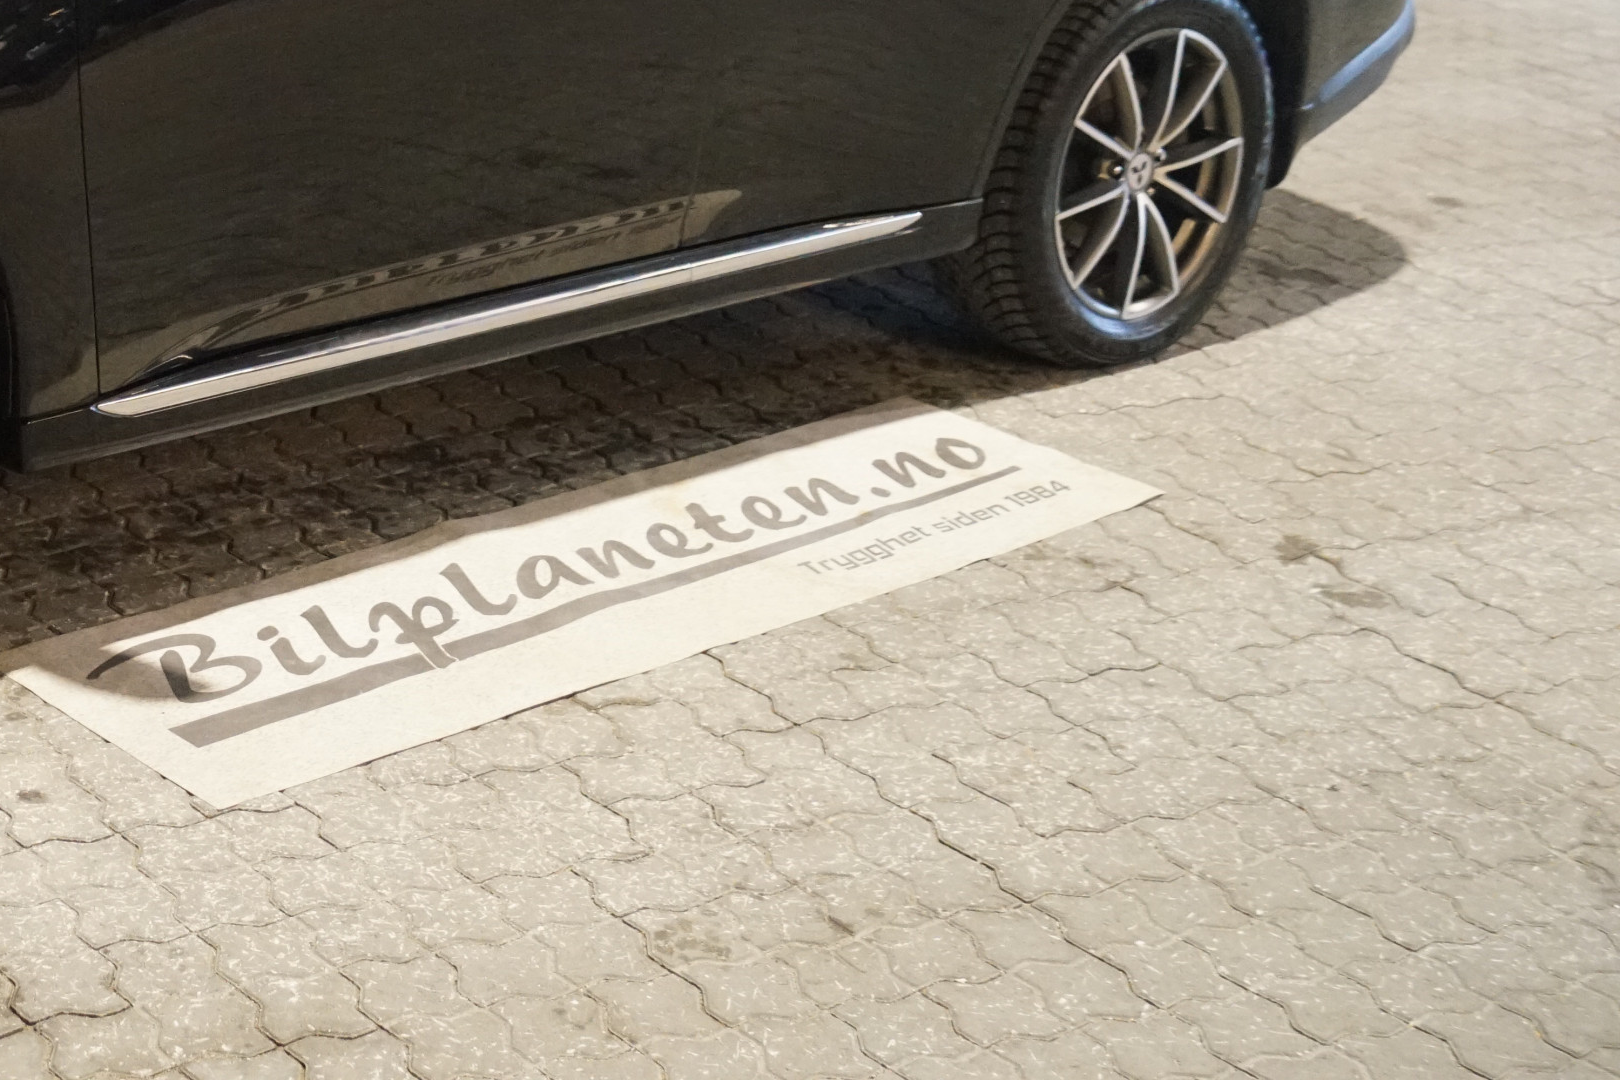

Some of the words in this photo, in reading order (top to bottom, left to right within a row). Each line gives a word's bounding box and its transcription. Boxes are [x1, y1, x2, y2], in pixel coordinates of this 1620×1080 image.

[86, 437, 986, 703] Bilplaneten.no
[796, 525, 933, 575] Trygghet
[932, 503, 1010, 534] siden
[1004, 480, 1071, 508] 1984
